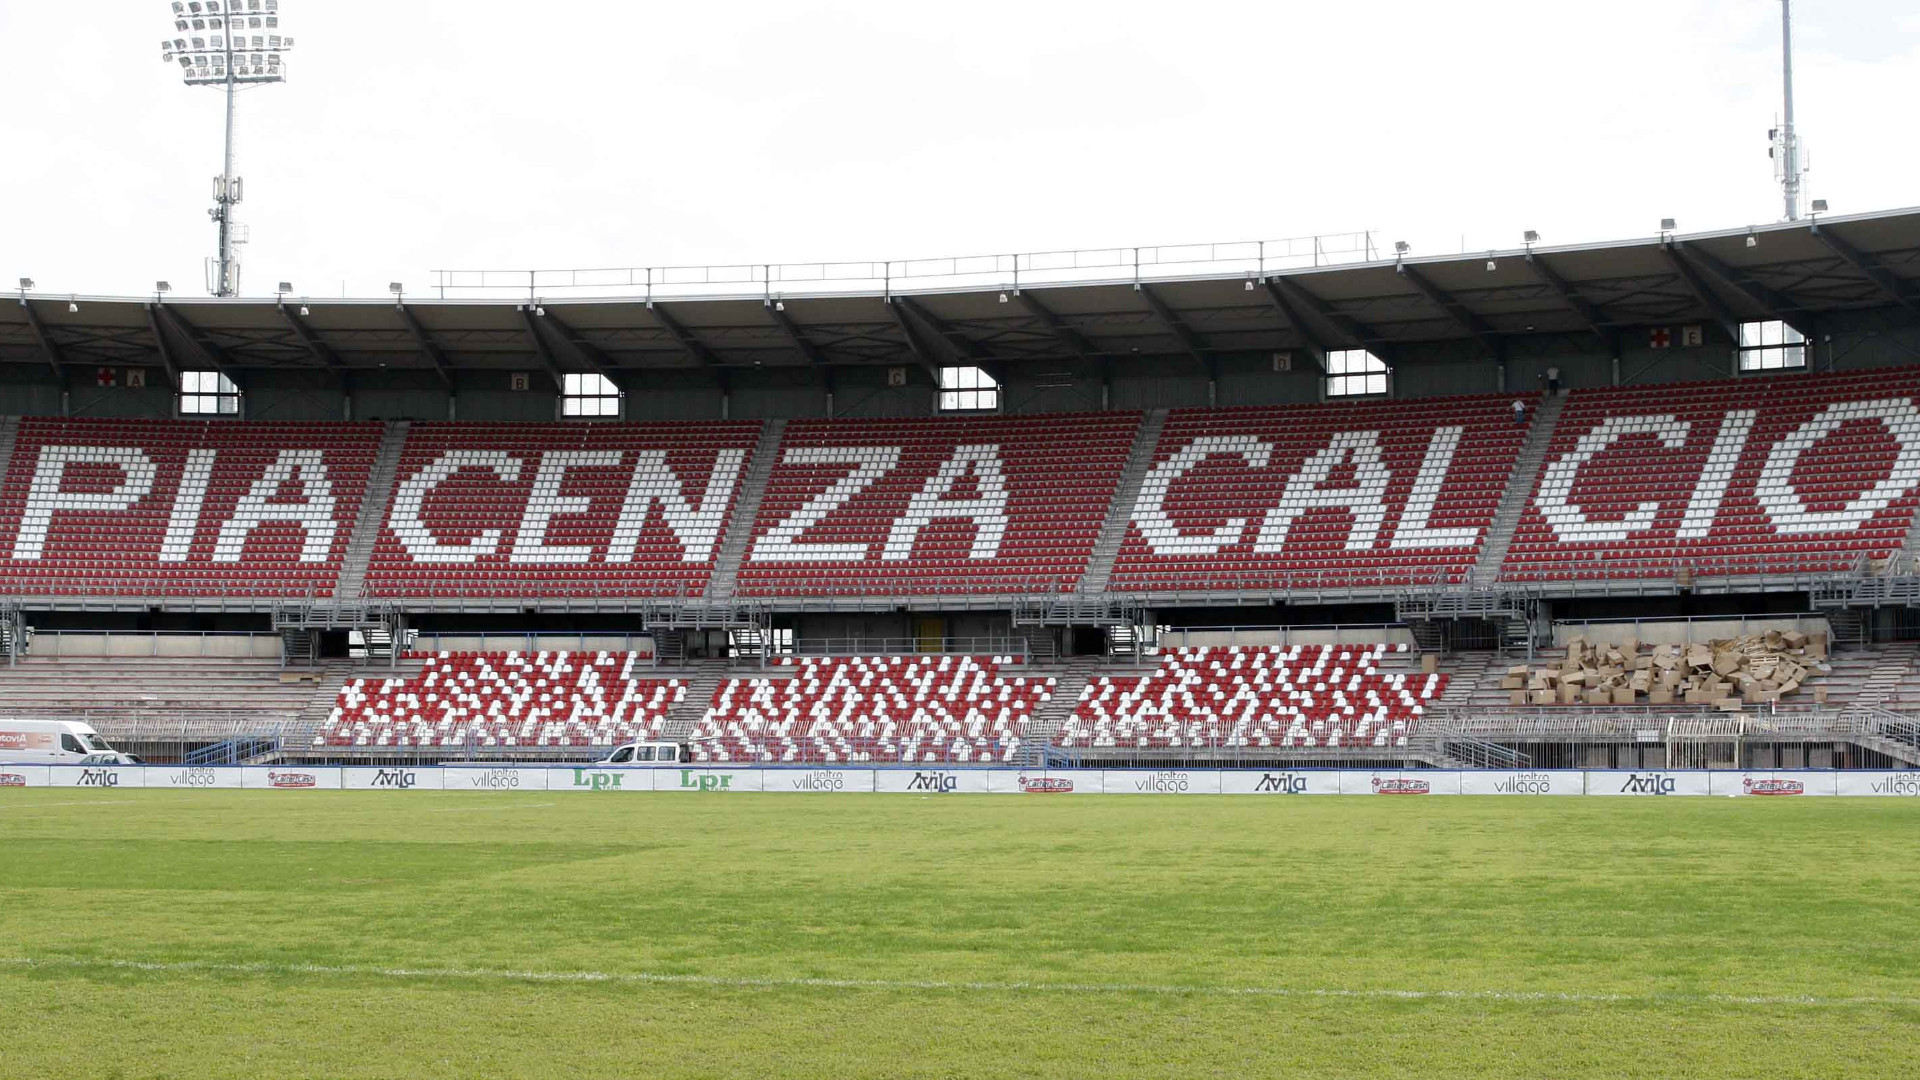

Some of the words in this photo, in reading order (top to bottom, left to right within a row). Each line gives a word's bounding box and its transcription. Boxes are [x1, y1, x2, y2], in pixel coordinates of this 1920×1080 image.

[1688, 332, 1696, 344] E
[132, 376, 140, 386] A
[516, 378, 524, 388] B
[893, 373, 901, 384] C
[12, 443, 1009, 563] PIACENZA
[1130, 397, 1920, 555] CALCIO
[170, 770, 215, 787] village
[471, 771, 519, 790] village
[573, 768, 624, 791] Lpr
[680, 770, 733, 791] Lpr
[793, 773, 843, 792] village
[1135, 774, 1188, 793] village
[1494, 776, 1550, 795] village
[1871, 776, 1920, 796] villag
